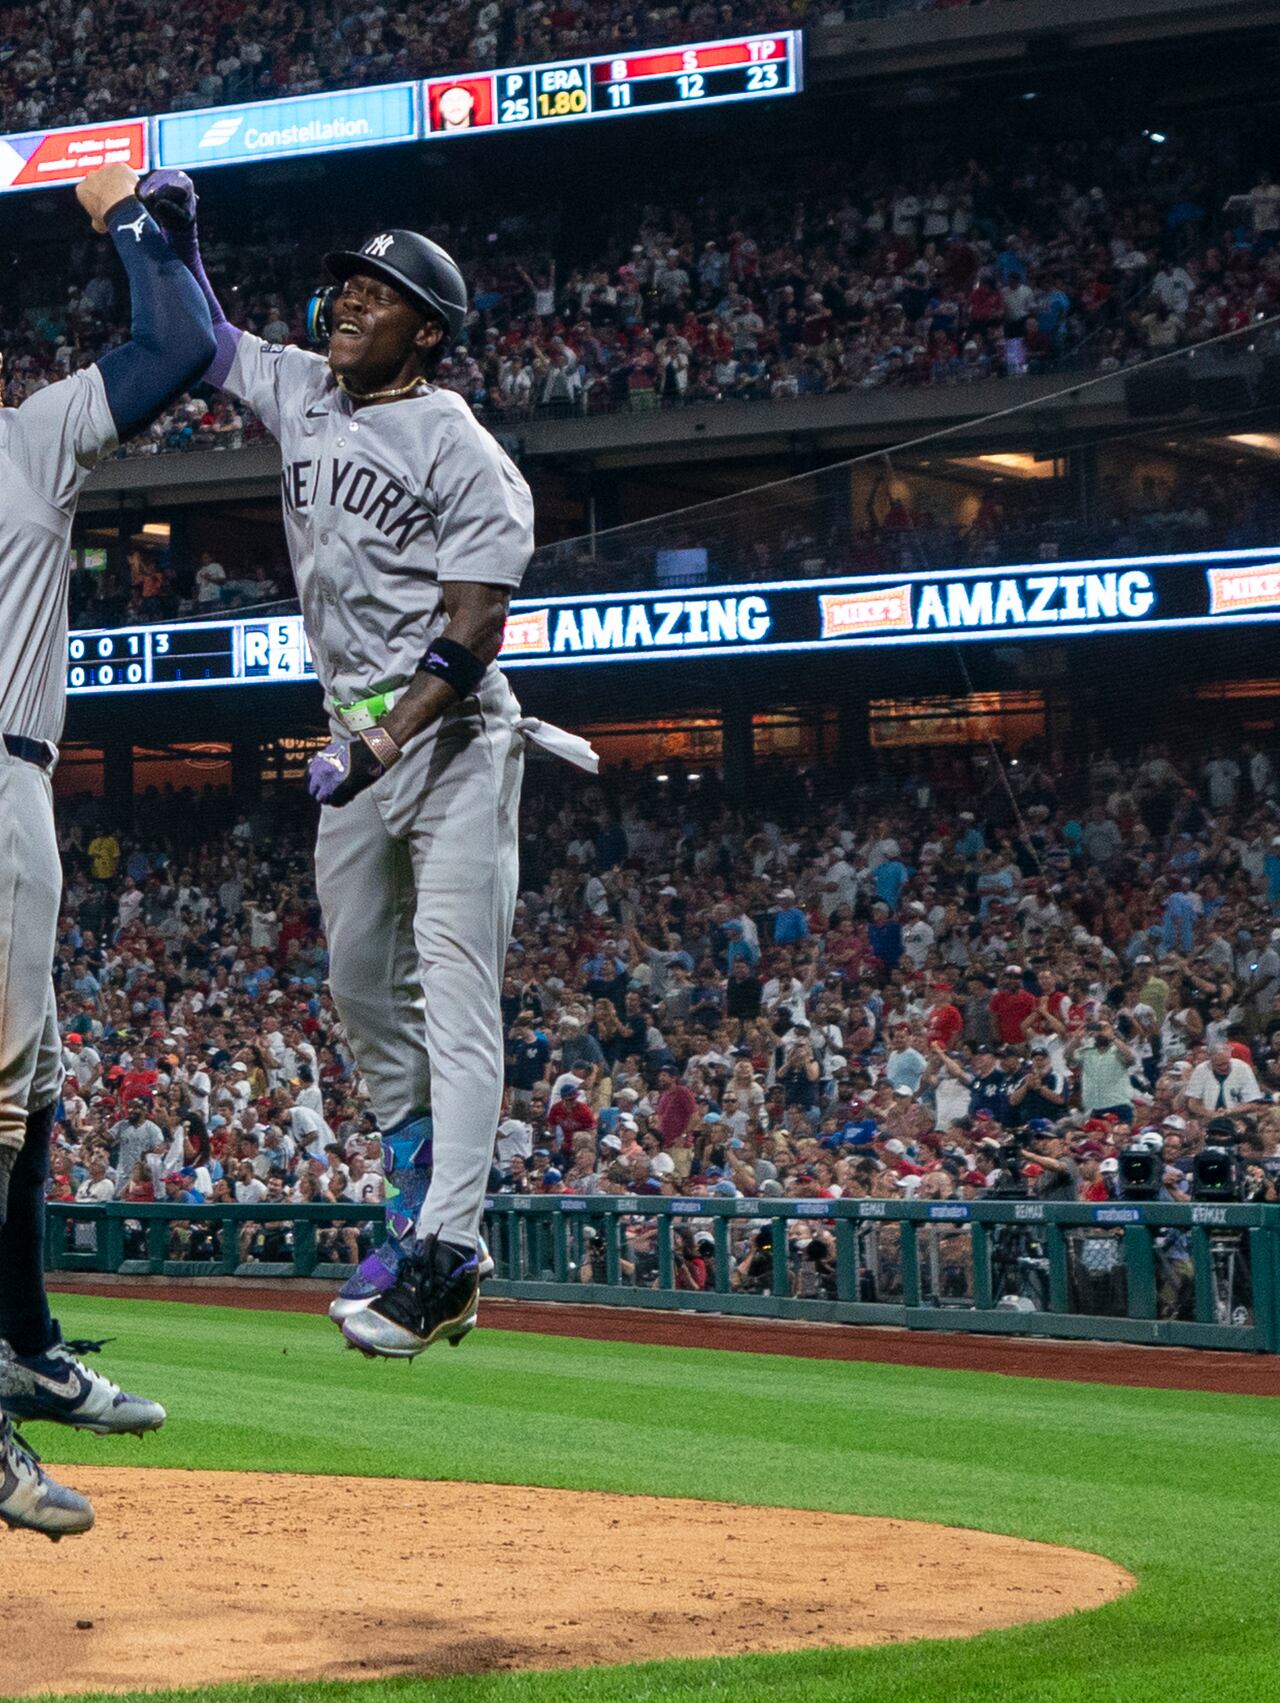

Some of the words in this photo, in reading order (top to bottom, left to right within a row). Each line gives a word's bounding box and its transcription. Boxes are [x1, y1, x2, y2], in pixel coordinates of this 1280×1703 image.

[611, 59, 627, 80] B
[682, 51, 698, 69] S
[746, 40, 775, 61] TP
[501, 98, 529, 121] 25
[538, 89, 587, 116] 1.80
[607, 83, 630, 107] 11
[676, 73, 704, 98] 12
[746, 64, 778, 90] 23
[507, 75, 523, 97] P
[542, 68, 583, 92] ERA
[244, 117, 369, 149] Constellation
[329, 457, 431, 549] YORK
[553, 596, 771, 651] AMAZING
[831, 599, 902, 625] MIKE'S
[917, 571, 1155, 629] AMAZING
[70, 639, 84, 659] 0
[98, 637, 113, 658] 0
[128, 636, 138, 655] 1
[155, 634, 169, 653] 3
[277, 626, 289, 645] 5
[245, 631, 268, 667] R
[70, 667, 85, 686] 0
[98, 665, 113, 685] 0
[127, 664, 142, 683] 0
[278, 653, 290, 672] 4
